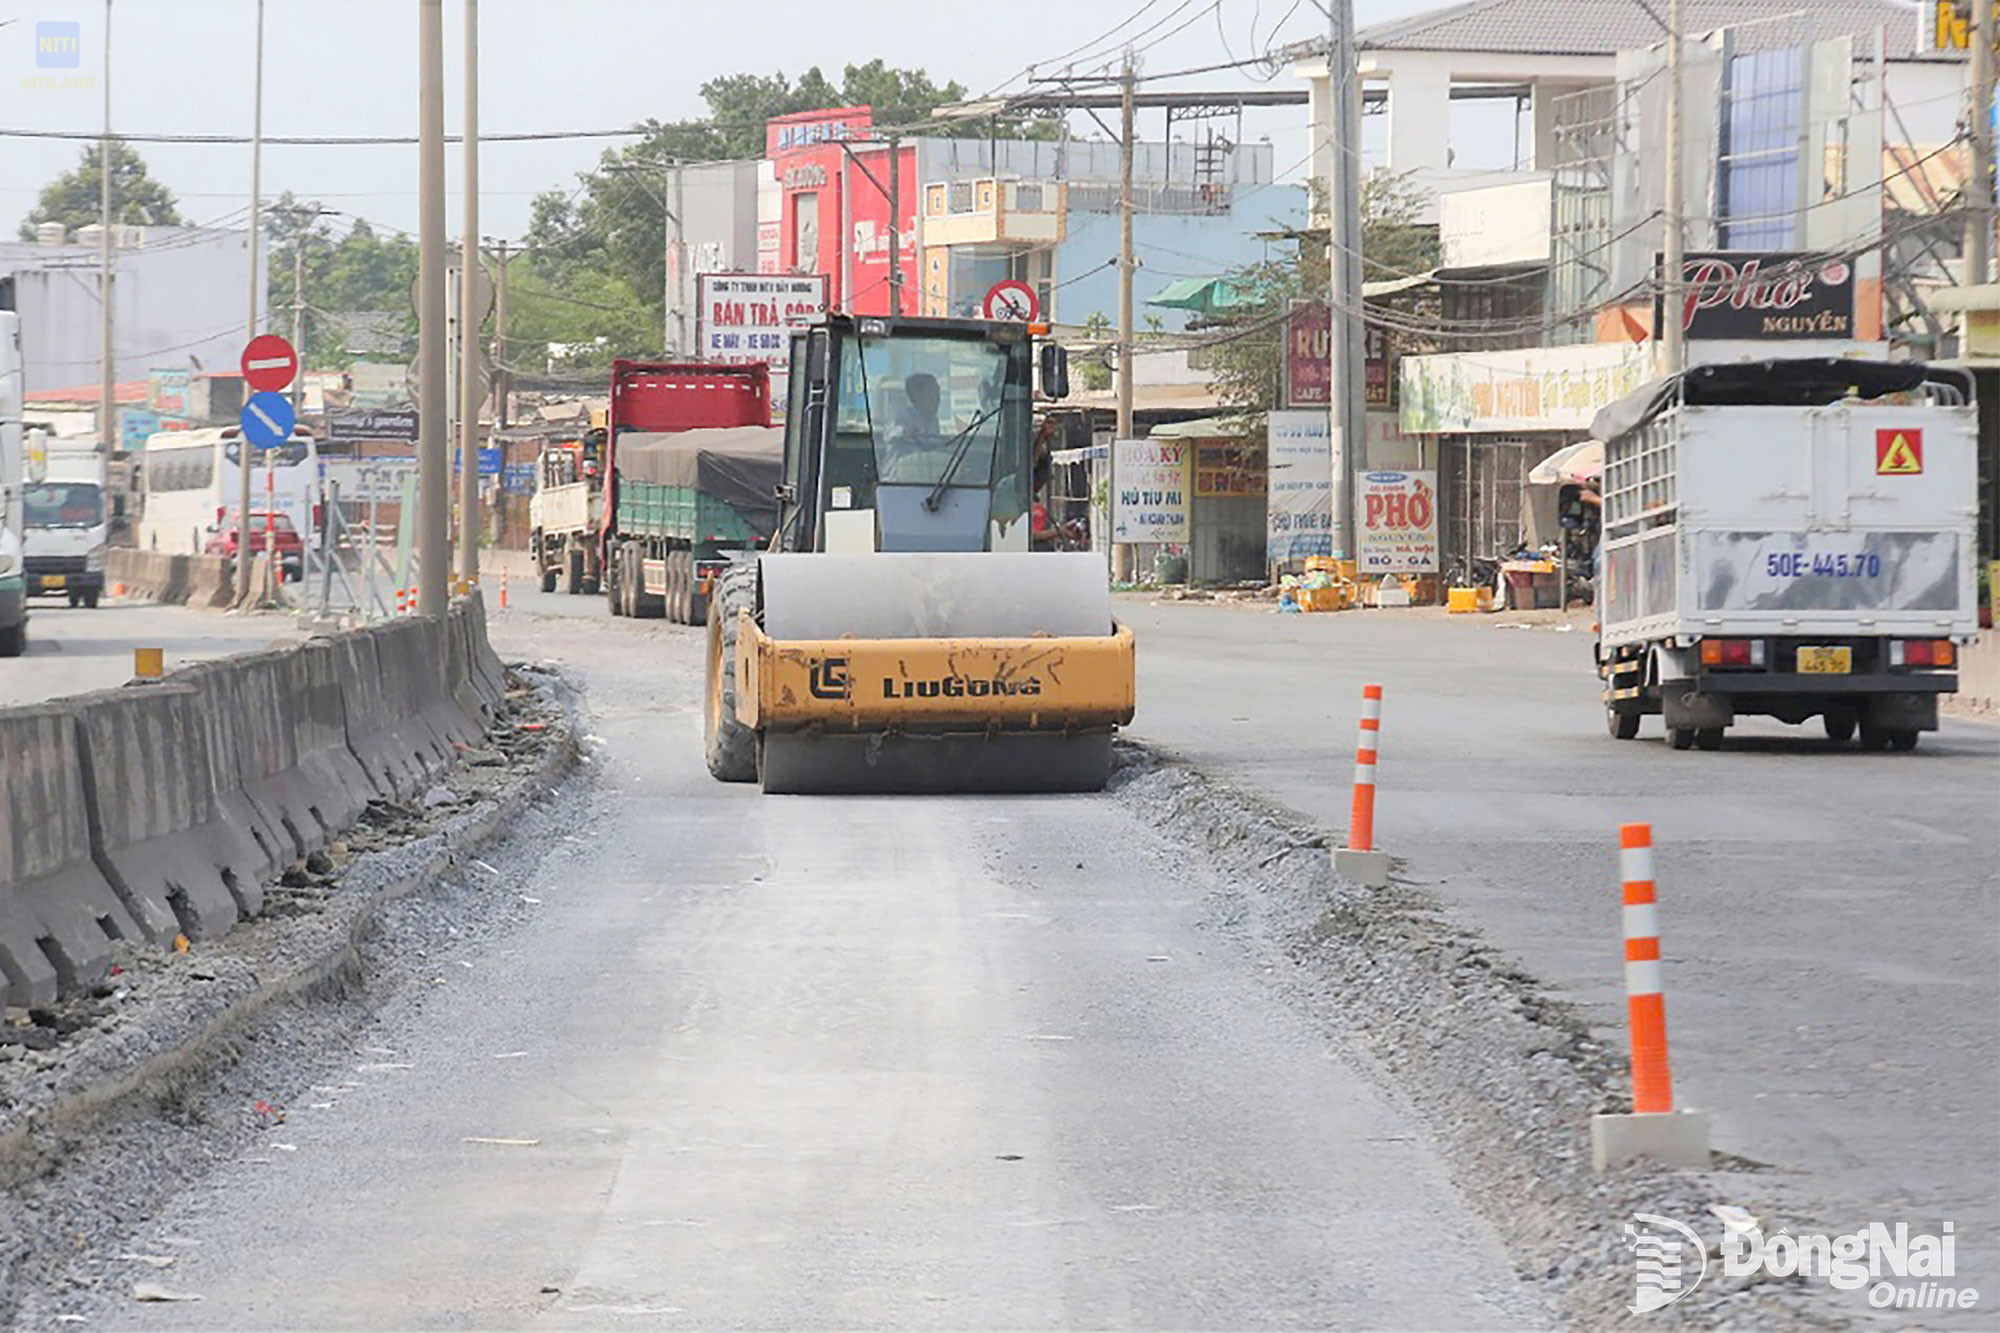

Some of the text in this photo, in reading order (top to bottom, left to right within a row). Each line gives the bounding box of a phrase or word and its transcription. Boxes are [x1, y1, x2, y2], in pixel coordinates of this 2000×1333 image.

[713, 298, 745, 327] BÁN
[749, 297, 779, 327] TRẢ
[1364, 479, 1434, 530] PHỞ
[1767, 553, 1880, 577] 50E-445.70
